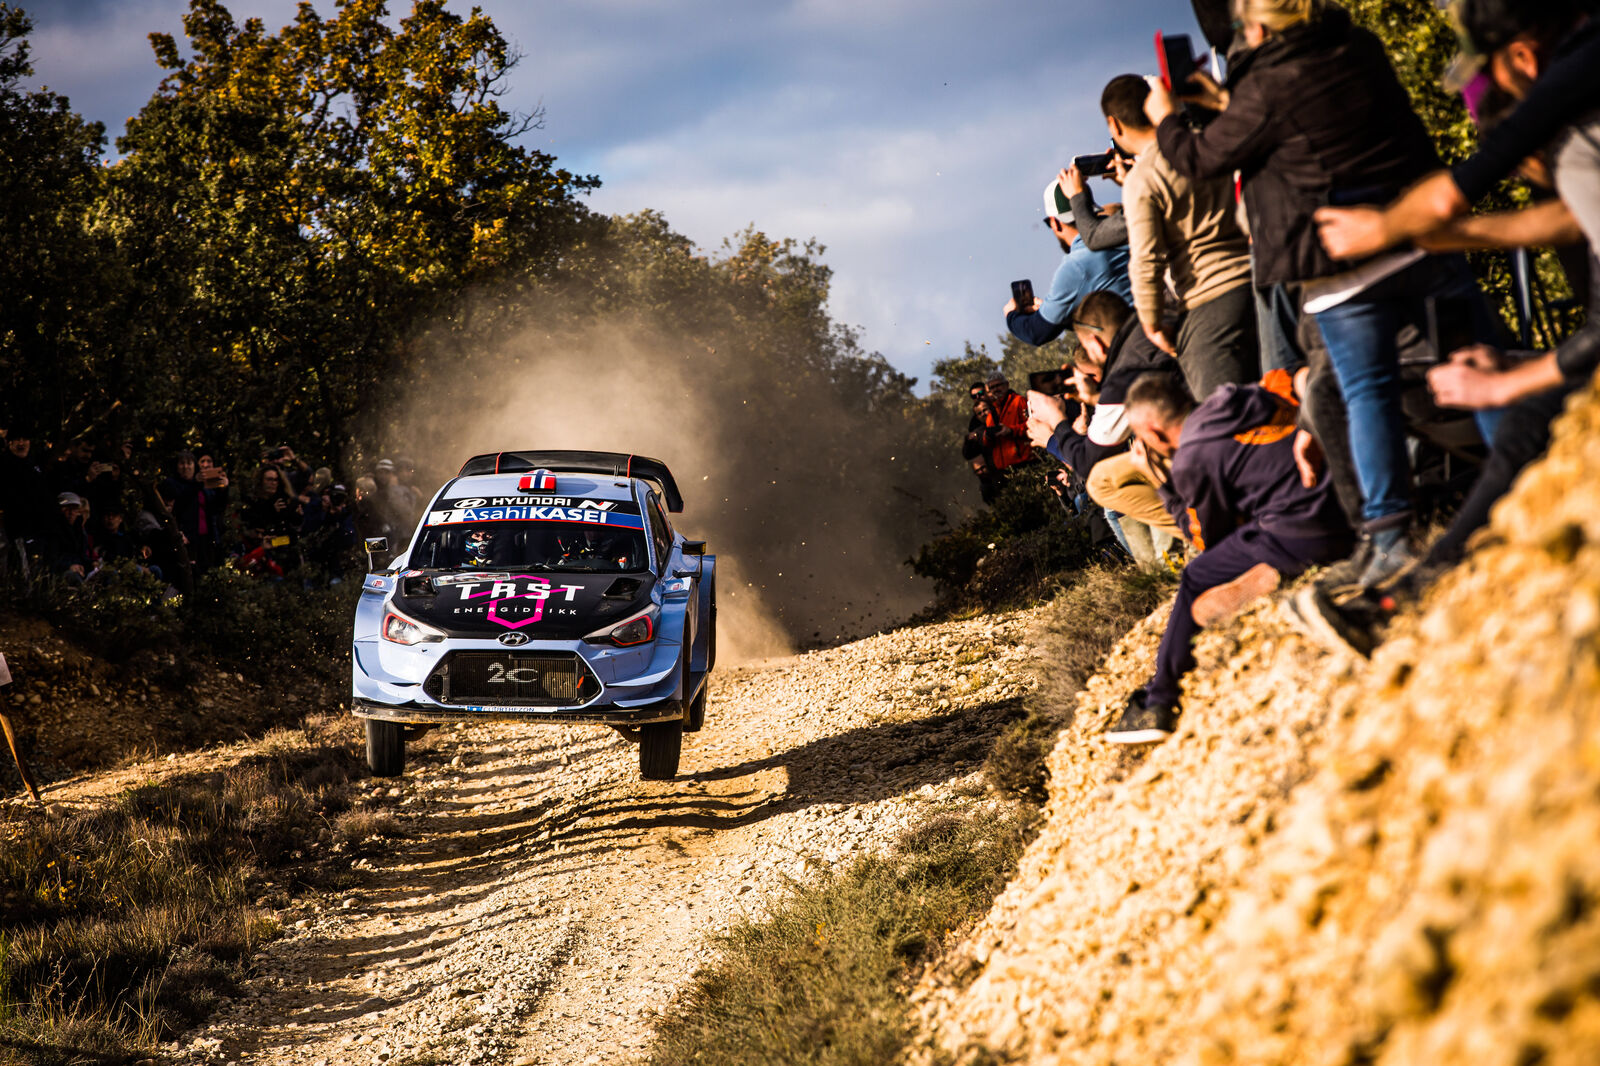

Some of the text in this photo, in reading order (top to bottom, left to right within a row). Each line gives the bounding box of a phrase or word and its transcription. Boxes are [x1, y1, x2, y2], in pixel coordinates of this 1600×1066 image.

[492, 497, 571, 507] HYUNDAI
[442, 511, 453, 522] 7
[455, 583, 585, 601] TRST
[454, 606, 577, 615] ENERGIDRIKK
